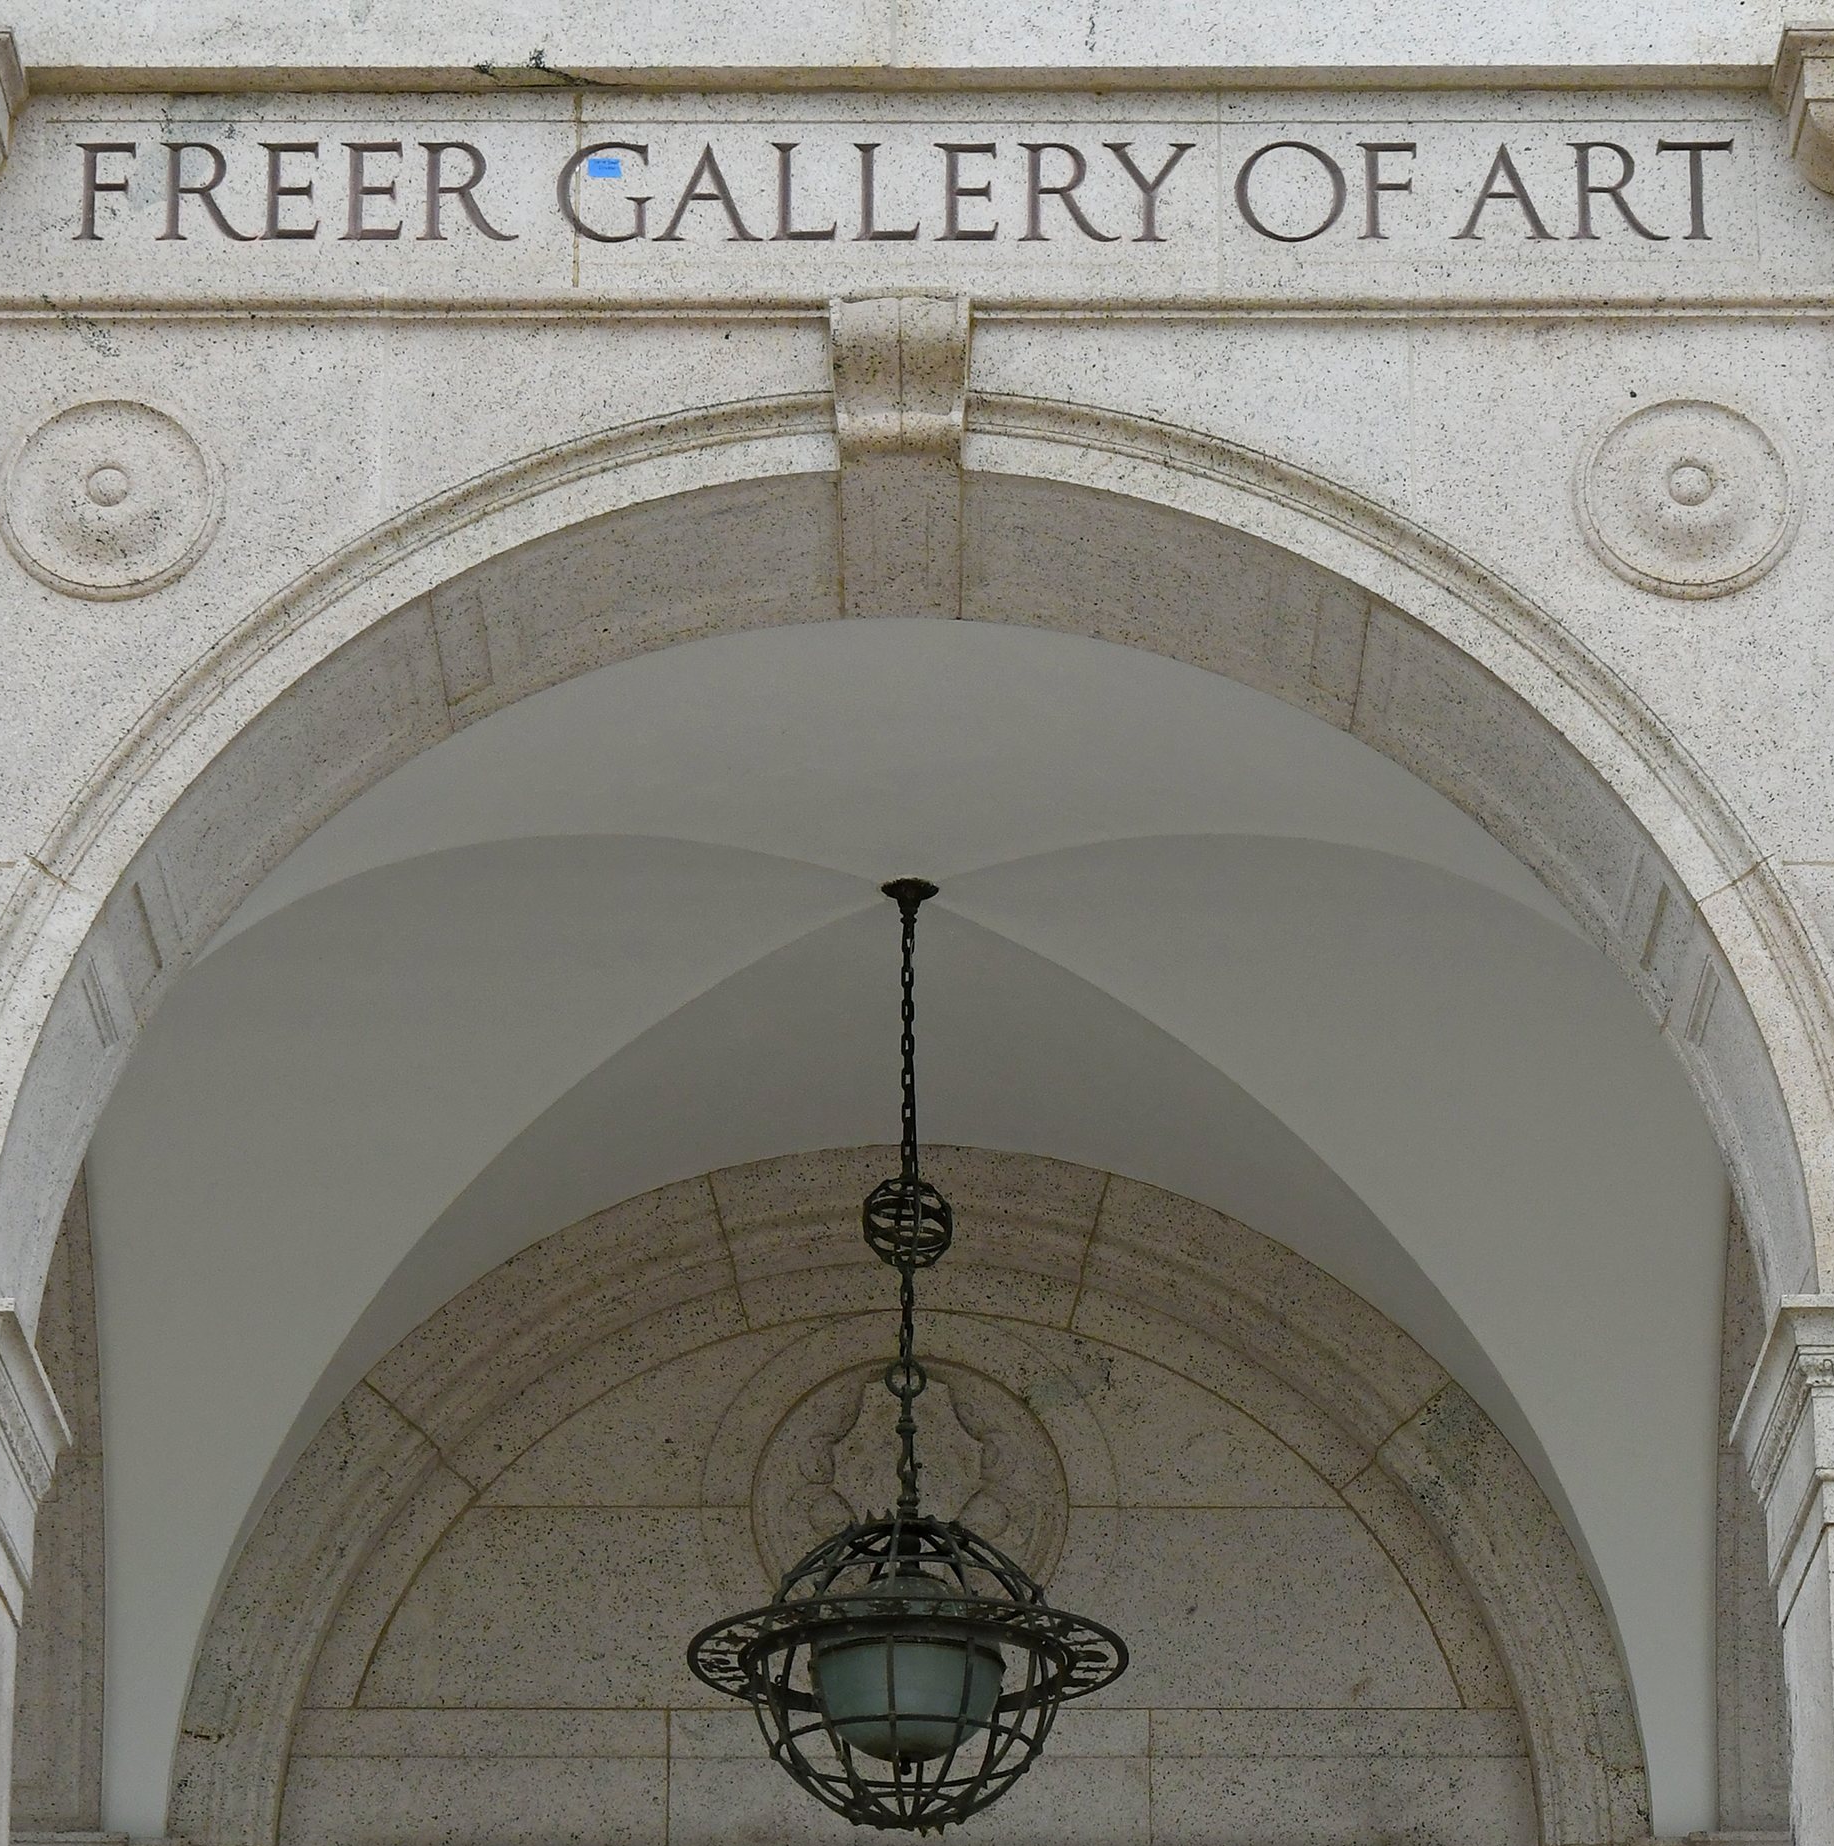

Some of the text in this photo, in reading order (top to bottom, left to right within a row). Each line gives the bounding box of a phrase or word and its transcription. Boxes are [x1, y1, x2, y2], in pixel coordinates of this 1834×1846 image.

[70, 138, 1735, 244] FREER GALLERY OF ART
